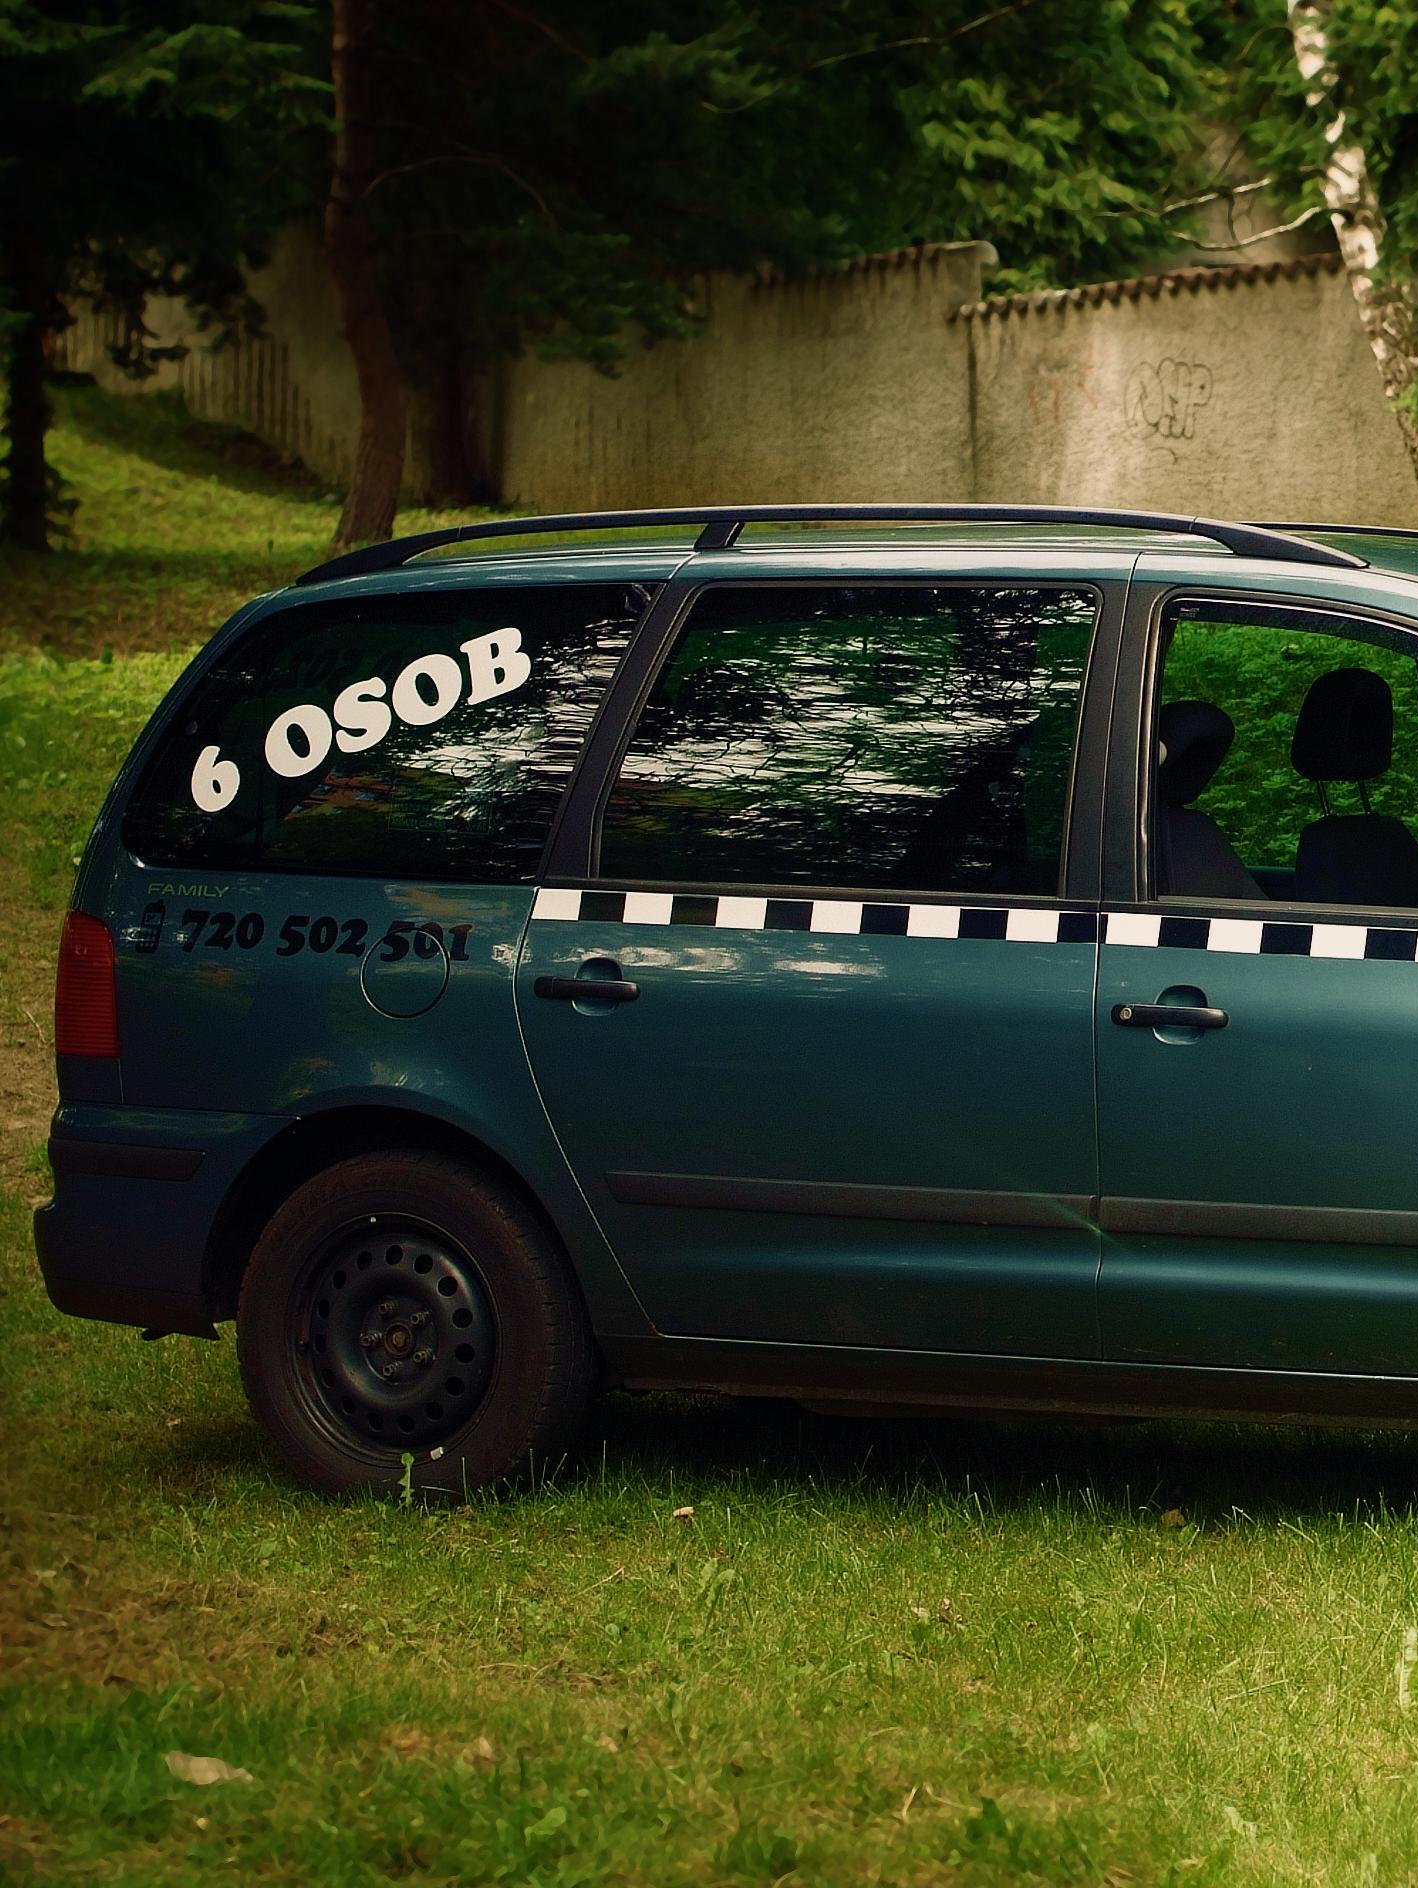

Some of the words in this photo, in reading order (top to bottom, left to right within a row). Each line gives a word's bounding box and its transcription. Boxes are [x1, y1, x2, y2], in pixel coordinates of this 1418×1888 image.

[190, 745, 241, 813] 6
[264, 626, 532, 778] OSOB
[148, 883, 229, 898] FAMILY
[181, 908, 265, 953] 720
[275, 915, 369, 958] 502
[379, 920, 473, 962] 501
